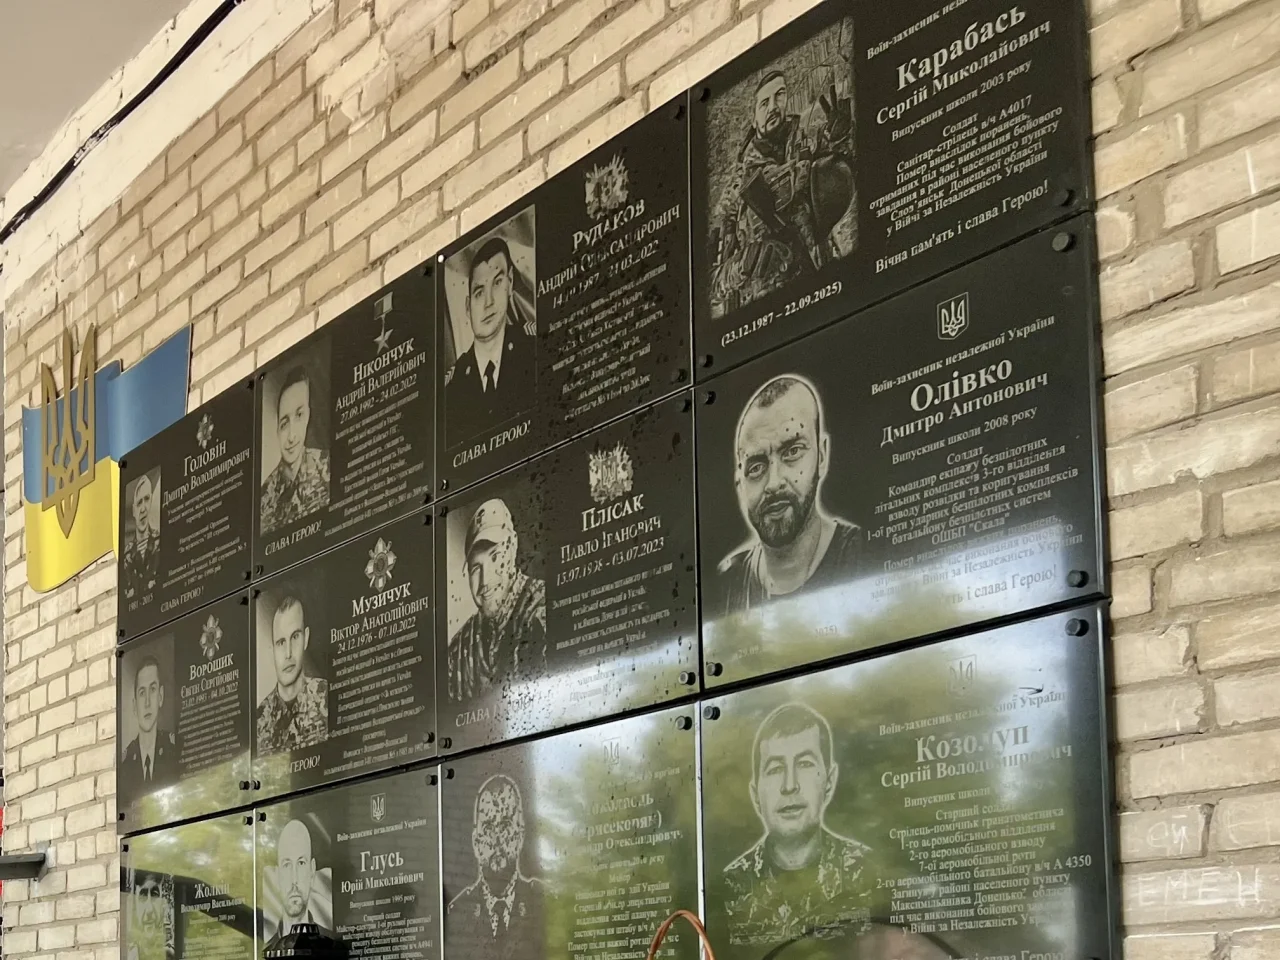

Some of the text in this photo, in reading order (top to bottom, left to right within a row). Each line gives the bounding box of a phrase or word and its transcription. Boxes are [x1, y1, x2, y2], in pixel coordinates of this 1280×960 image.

[867, 9, 939, 61] Воїн-захисник
[896, 0, 1025, 92] Карабась
[876, 19, 1050, 127] Сергій Миколайович
[891, 58, 1031, 141] Випускник школи 2003 року
[942, 112, 978, 139] Солдат
[869, 105, 1062, 209] отриманих виконання бойового
[896, 93, 1031, 173] Санітар-стрілець А4017
[875, 119, 1059, 219] завдання районі населеного пункту
[896, 163, 926, 185] Помер
[929, 137, 977, 168] внаслідок
[934, 172, 1002, 212] Незалежність
[1005, 149, 1047, 176] України
[949, 159, 1000, 193] Донецької
[1003, 138, 1042, 167] області
[875, 179, 1048, 274] Вічна пам'ять слава Герою!
[721, 278, 841, 348] (23.12.1987 22.09.2025)
[871, 315, 1054, 396] Воїн-захисник незалежної України
[879, 373, 1048, 445] Дмитро Антонович
[909, 357, 1013, 415] Олівко
[183, 436, 226, 477] Головін
[453, 418, 530, 469] СЛАВА ГЕРОЮ!
[891, 405, 1037, 464] Випускник школи 2008 року
[946, 446, 984, 467] Солдат
[874, 445, 1066, 515] літальних комплексів 3-го відділення
[888, 437, 1047, 497] Командир екіпажу безпілотних
[888, 462, 1050, 522] взводу розвідки коригування
[162, 482, 189, 506] Дмитро
[885, 521, 907, 537] роти
[909, 508, 949, 529] ударних
[951, 489, 1013, 515] безпілотних
[1016, 467, 1078, 495] комплексів
[891, 522, 945, 544] батальйону
[1013, 489, 1051, 509] систем
[264, 518, 321, 557] СЛАВА ГЕРОЮ!
[878, 714, 951, 736] Воїн-захисник
[881, 763, 930, 788] Сергій
[904, 792, 955, 807] Випускник
[359, 850, 404, 875] Глусь
[876, 877, 894, 888] 2-го
[1065, 854, 1092, 869] 4350
[909, 835, 1046, 861] 2-го аеромобільного взводу
[939, 851, 1010, 870] аеромобільної
[1011, 851, 1036, 863] роти
[194, 878, 229, 899] Жолкін
[340, 872, 424, 895] Юрій Миколайович
[973, 876, 1029, 891] населеного
[1032, 872, 1071, 886] пункту
[924, 907, 974, 920] виконання
[950, 915, 1017, 930] Незалежність
